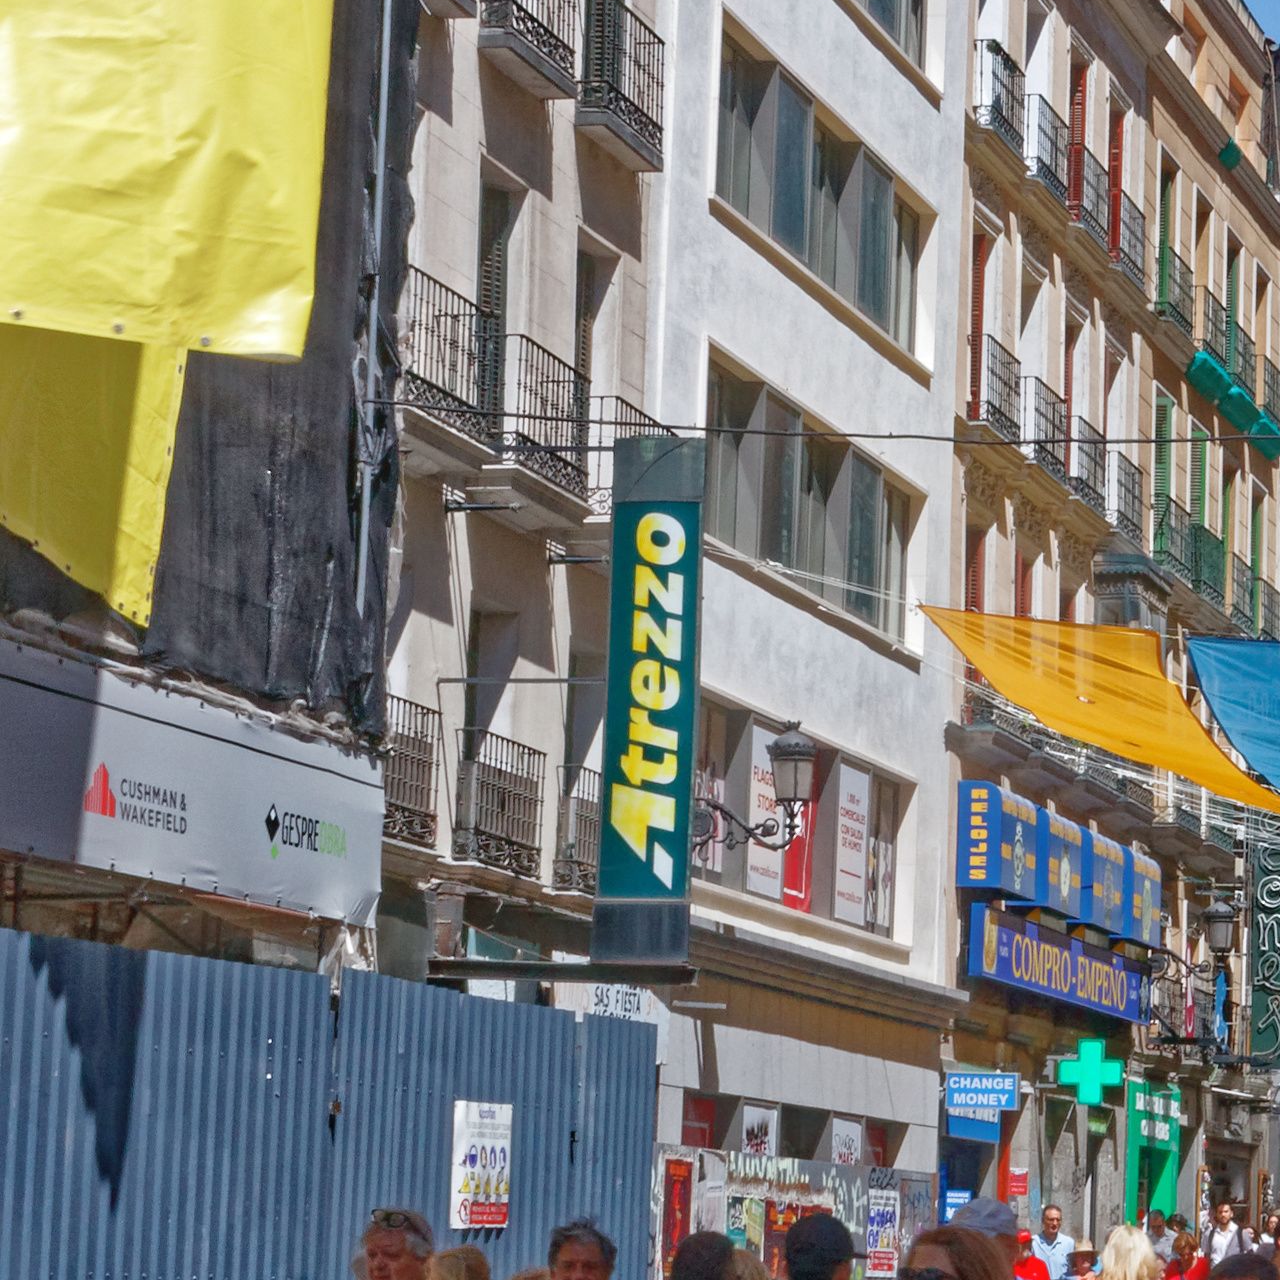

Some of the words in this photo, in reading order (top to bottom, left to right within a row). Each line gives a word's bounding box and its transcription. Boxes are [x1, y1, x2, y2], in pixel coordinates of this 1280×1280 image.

[610, 511, 687, 891] Atrezzo
[120, 778, 178, 806] CUSHMAN
[180, 793, 187, 811] &
[119, 801, 187, 835] WAKEFIELD
[969, 788, 988, 880] RELOJES
[949, 1076, 1014, 1090] CHANGE
[953, 1093, 1009, 1106] MONEY
